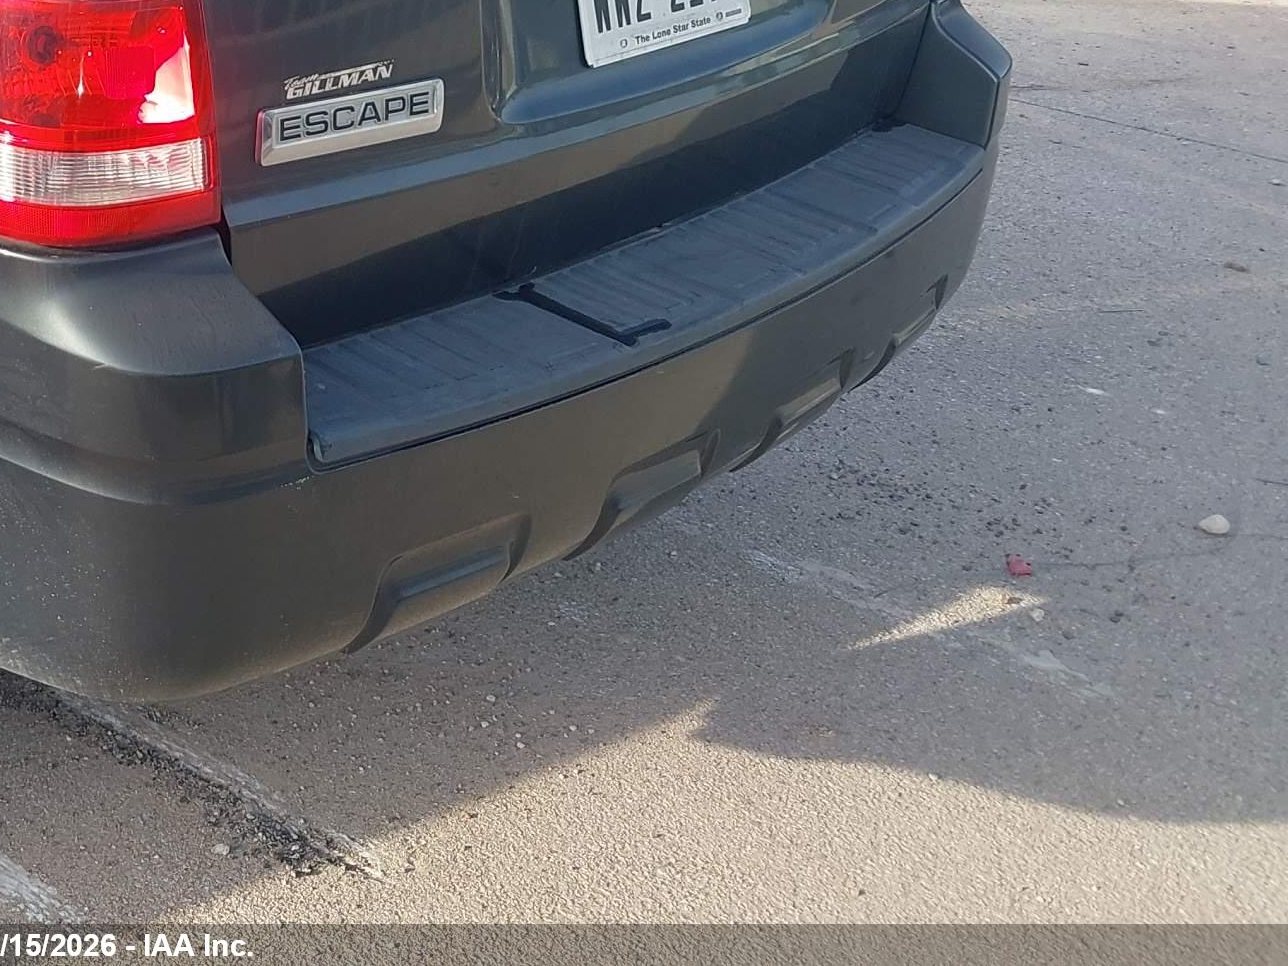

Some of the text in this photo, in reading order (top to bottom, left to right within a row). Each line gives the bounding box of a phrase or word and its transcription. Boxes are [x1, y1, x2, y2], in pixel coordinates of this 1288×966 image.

[635, 16, 711, 45] The Lone Star State
[285, 63, 394, 101] GILLMAN
[279, 91, 430, 142] ESCAPE
